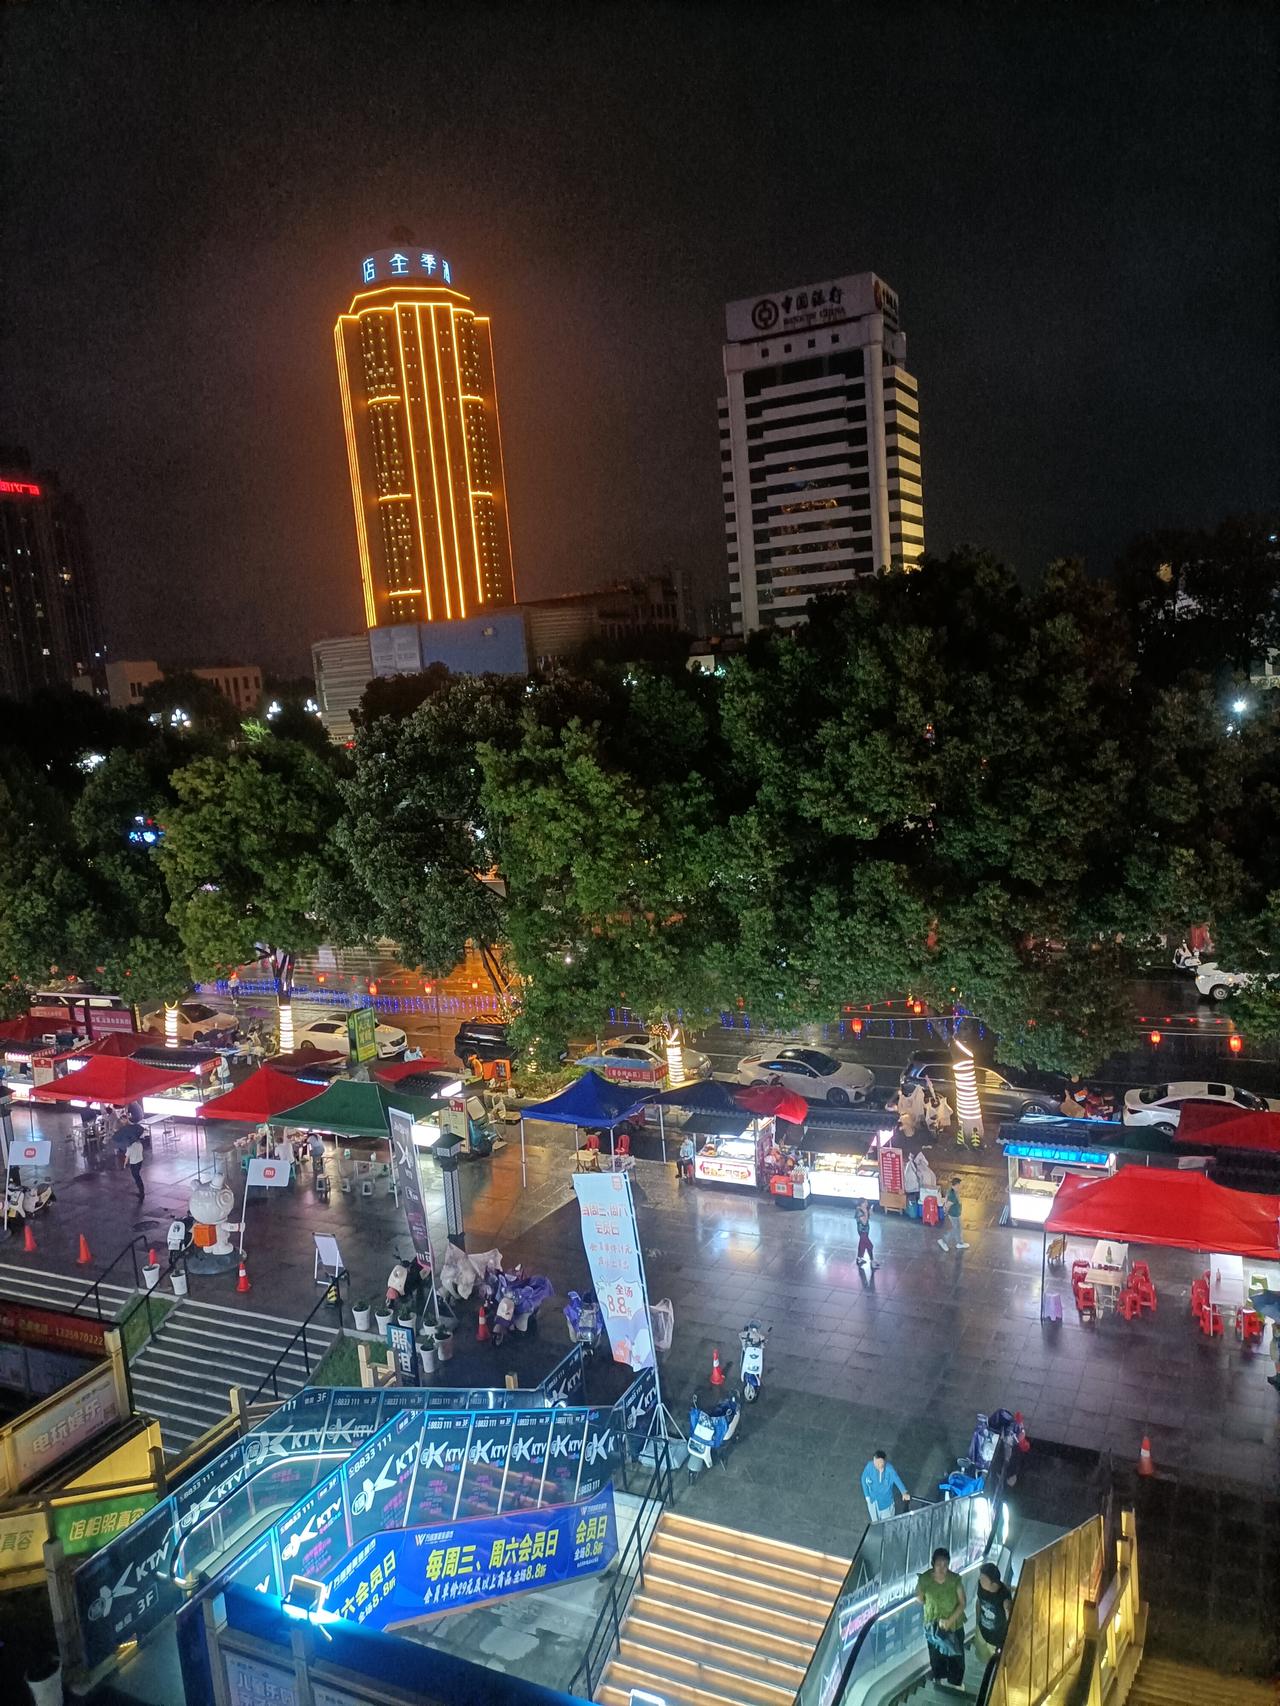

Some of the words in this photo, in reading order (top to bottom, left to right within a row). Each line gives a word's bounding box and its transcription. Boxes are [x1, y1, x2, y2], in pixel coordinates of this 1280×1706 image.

[616, 1284, 633, 1298] 全场
[567, 1368, 581, 1391] KTV
[290, 1428, 325, 1450] KTV
[352, 1425, 374, 1438] KTV
[445, 1448, 465, 1462] KTV
[490, 1445, 508, 1458] KTV
[530, 1442, 547, 1455] KTV
[568, 1440, 583, 1453] KTV
[354, 1447, 376, 1473] 8833
[216, 1469, 245, 1498] KTV
[316, 1496, 342, 1529] KTV
[0, 1530, 34, 1551] 真容
[576, 1515, 607, 1545] 会员日
[425, 1528, 560, 1582] 每周三、周六会员日
[334, 1549, 397, 1619] 六会员日
[137, 1590, 154, 1616] 3F
